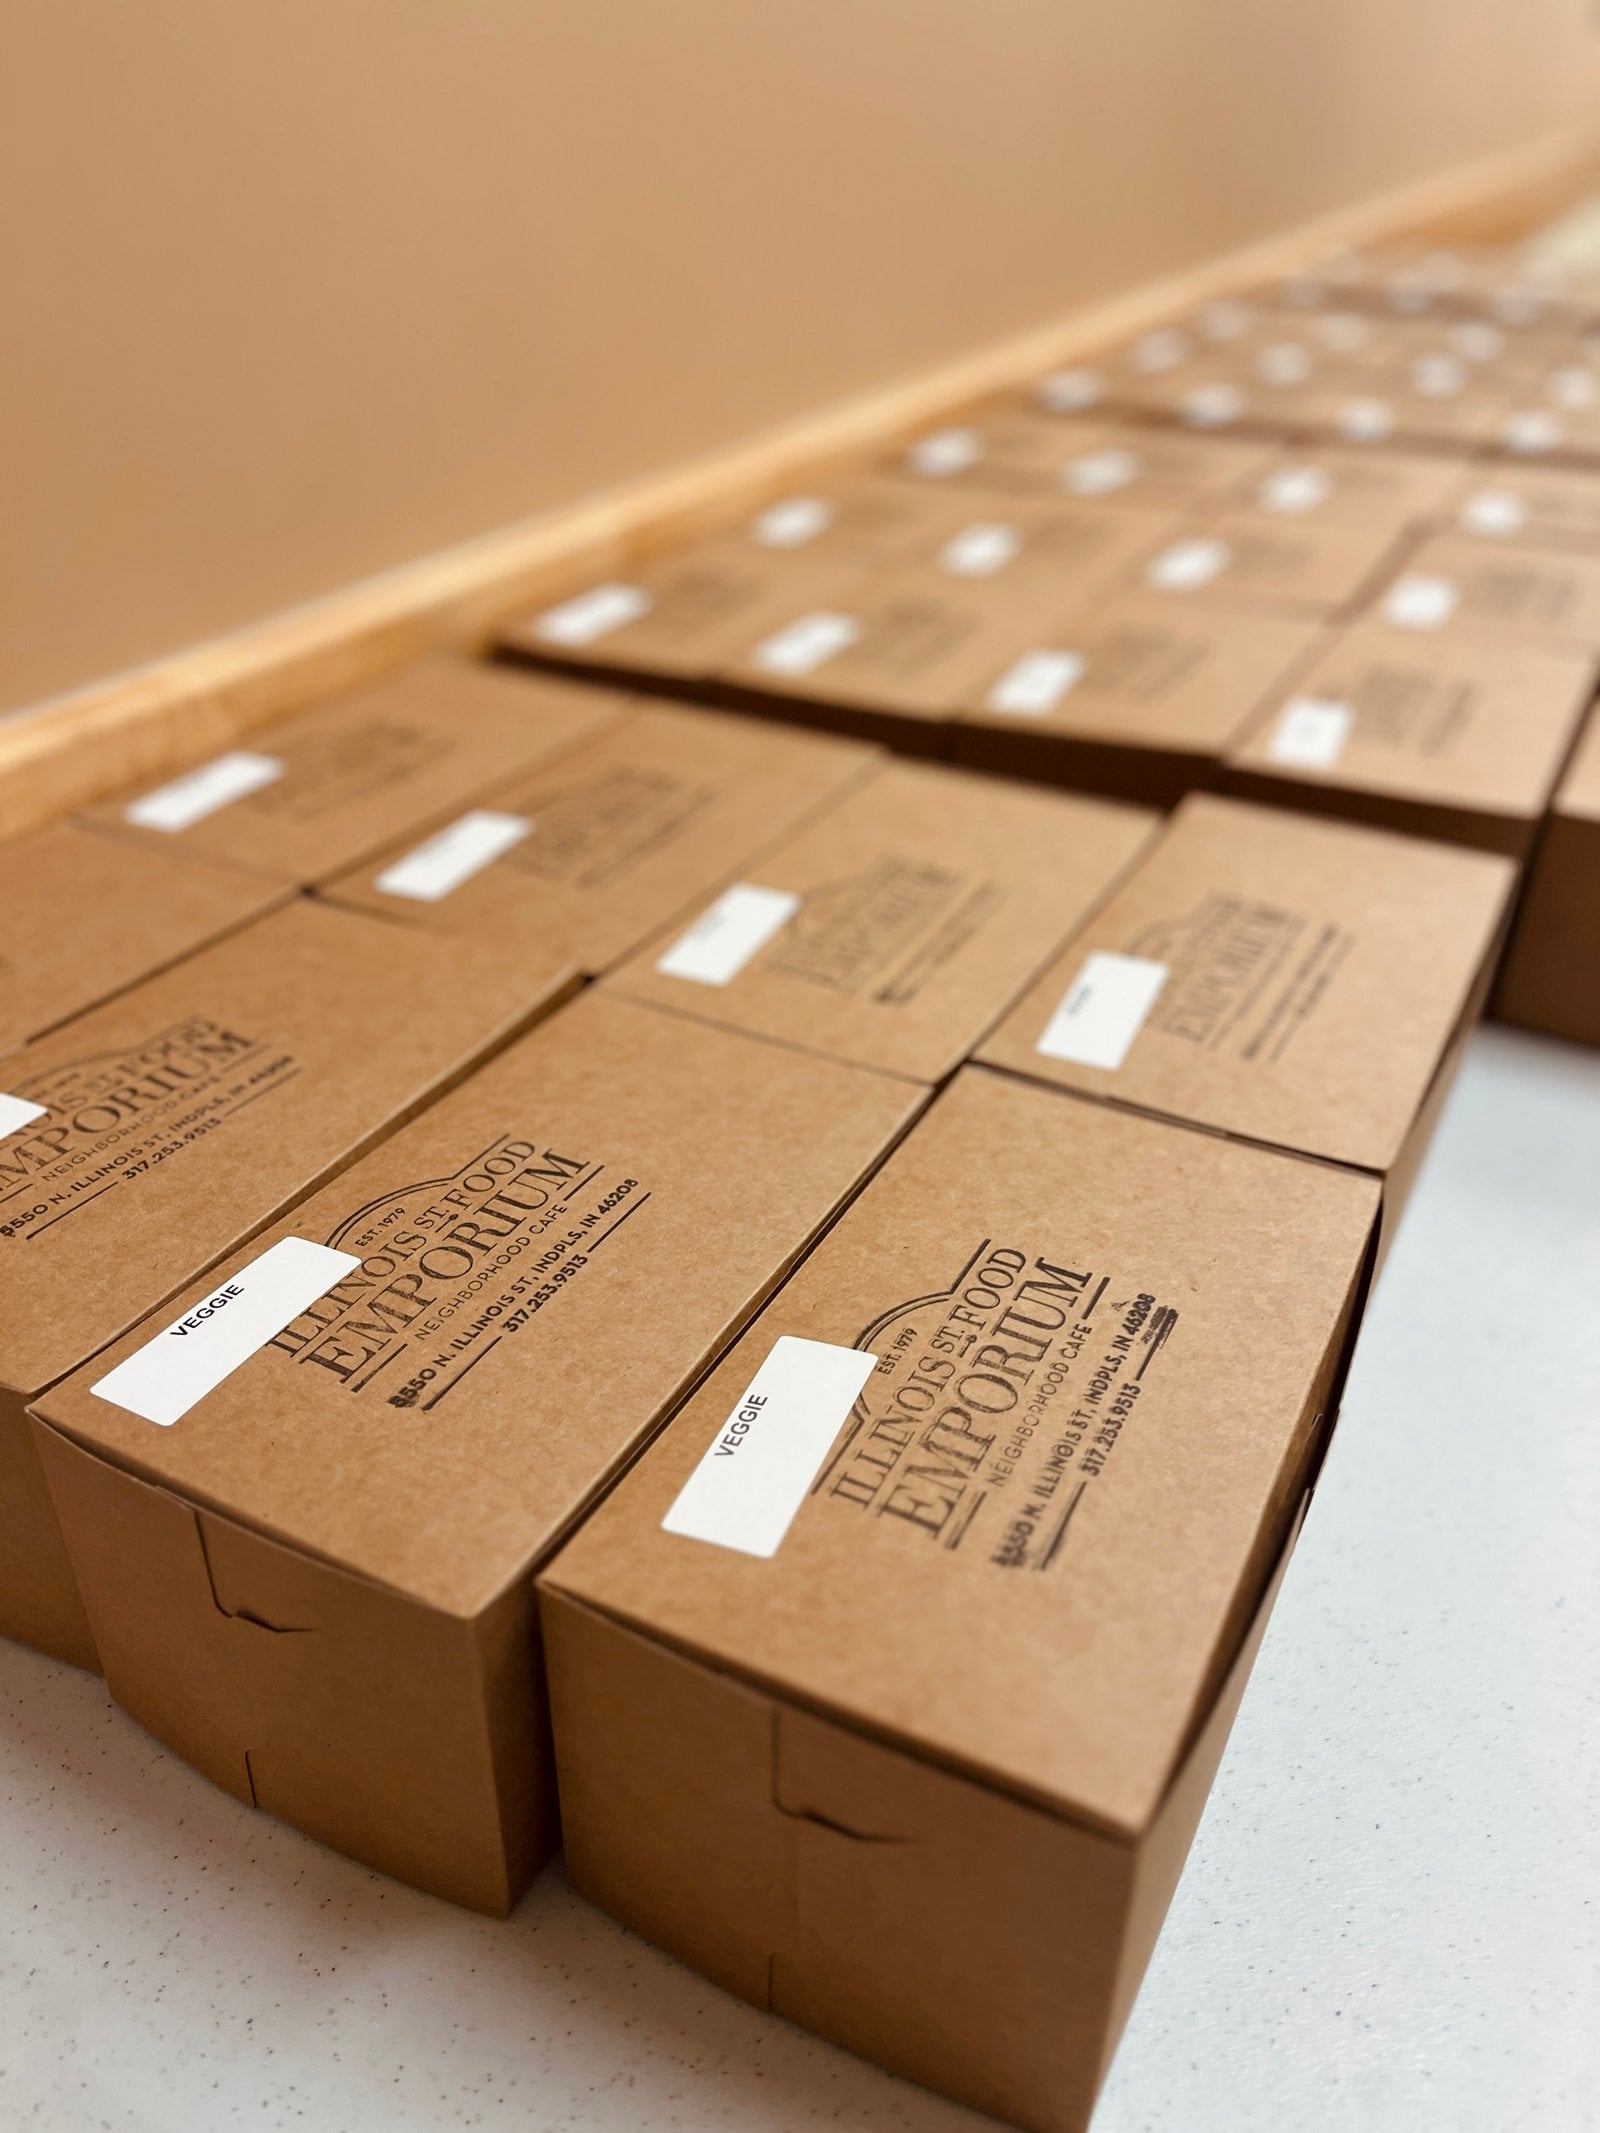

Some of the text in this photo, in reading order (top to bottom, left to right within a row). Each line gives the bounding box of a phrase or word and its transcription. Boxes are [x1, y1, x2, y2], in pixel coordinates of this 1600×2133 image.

[0, 1029, 252, 1191] MPORIUM
[42, 1100, 178, 1182] NEIGHBORHOOD
[49, 1193, 72, 1206] N.
[70, 1147, 143, 1192] ILLINOIS
[121, 1118, 222, 1180] 317.253.9513
[265, 1141, 536, 1358] ILLINOIS ST. FOOD
[355, 1207, 406, 1247] EST. 1979
[299, 1148, 591, 1384] EMPORIUM
[414, 1203, 569, 1341] NEIGHBORHOOD CAFE
[433, 1352, 458, 1368] N.
[450, 1293, 516, 1351] ILLINOIS
[510, 1276, 540, 1294] ST,
[531, 1230, 588, 1274] INDPLS,
[579, 1213, 602, 1230] IN
[597, 1178, 639, 1215] 46208
[502, 1253, 589, 1333] 317.253.9513
[169, 1283, 245, 1339] VEGGIE
[1112, 1333, 1134, 1352] IN
[1122, 1292, 1156, 1336] 46208
[829, 1247, 1027, 1511] ILLINOIS ST. FOOD
[877, 1327, 919, 1375] EST. 1979
[1084, 1354, 1127, 1406] INDPLS,
[714, 1393, 769, 1459] VEGGIE
[876, 1256, 1094, 1540] EMPORIUM
[985, 1322, 1093, 1488] NEIGHBORHOOD CAFE
[1070, 1407, 1098, 1431] ST,
[1078, 1382, 1141, 1477] 317.253.9513
[1032, 1430, 1083, 1500] ILLINOIS
[1023, 1501, 1047, 1522] N.
